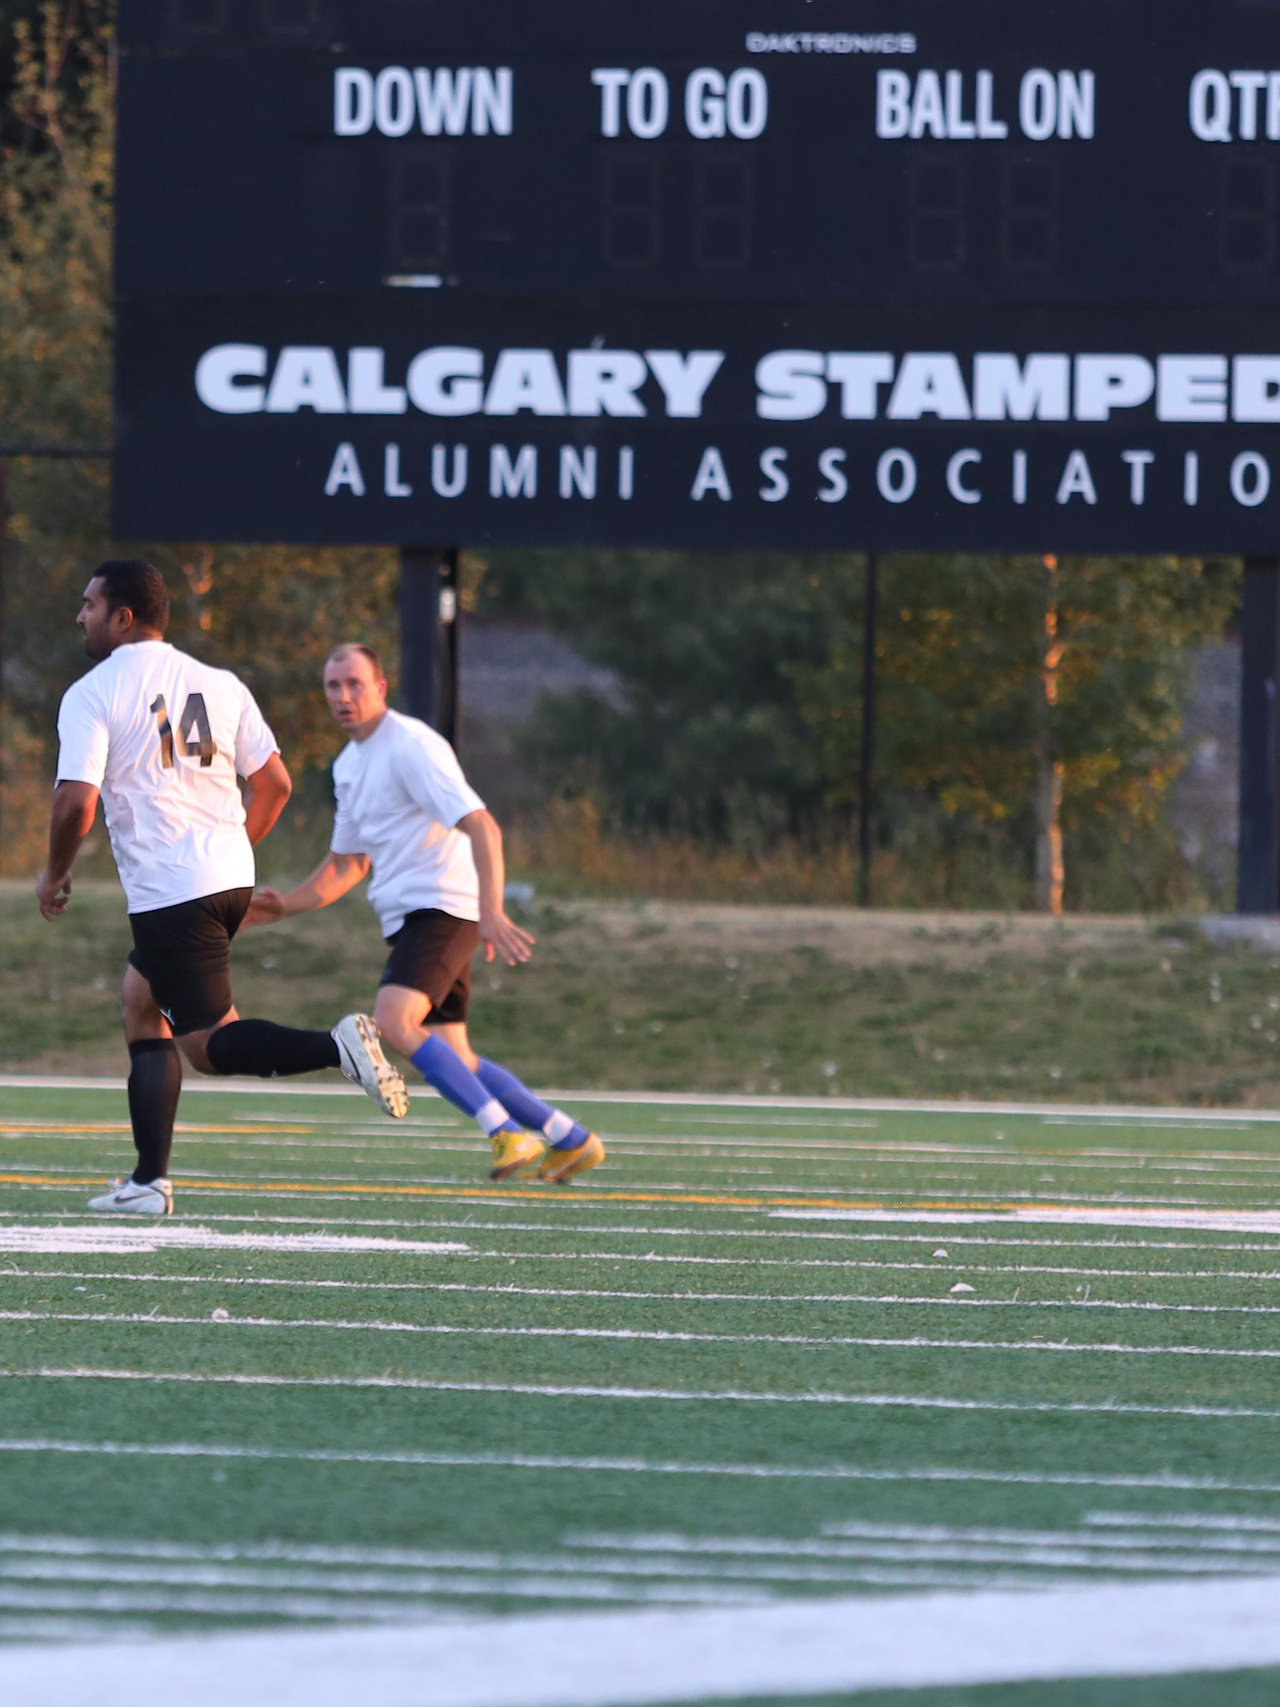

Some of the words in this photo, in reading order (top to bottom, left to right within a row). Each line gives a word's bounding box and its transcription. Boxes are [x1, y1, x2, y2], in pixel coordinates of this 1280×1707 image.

[745, 31, 918, 54] DAKTRONICS
[333, 66, 514, 137] DOWN
[591, 67, 670, 139] TO
[684, 68, 769, 139] GO
[876, 69, 1008, 140] BALL
[1019, 68, 1096, 141] ON
[194, 342, 726, 419] CALGARY
[754, 349, 1280, 423] STAMPED
[324, 442, 634, 501] ALUMNI
[690, 446, 1271, 508] ASSOCIATIO
[149, 692, 217, 769] 14
